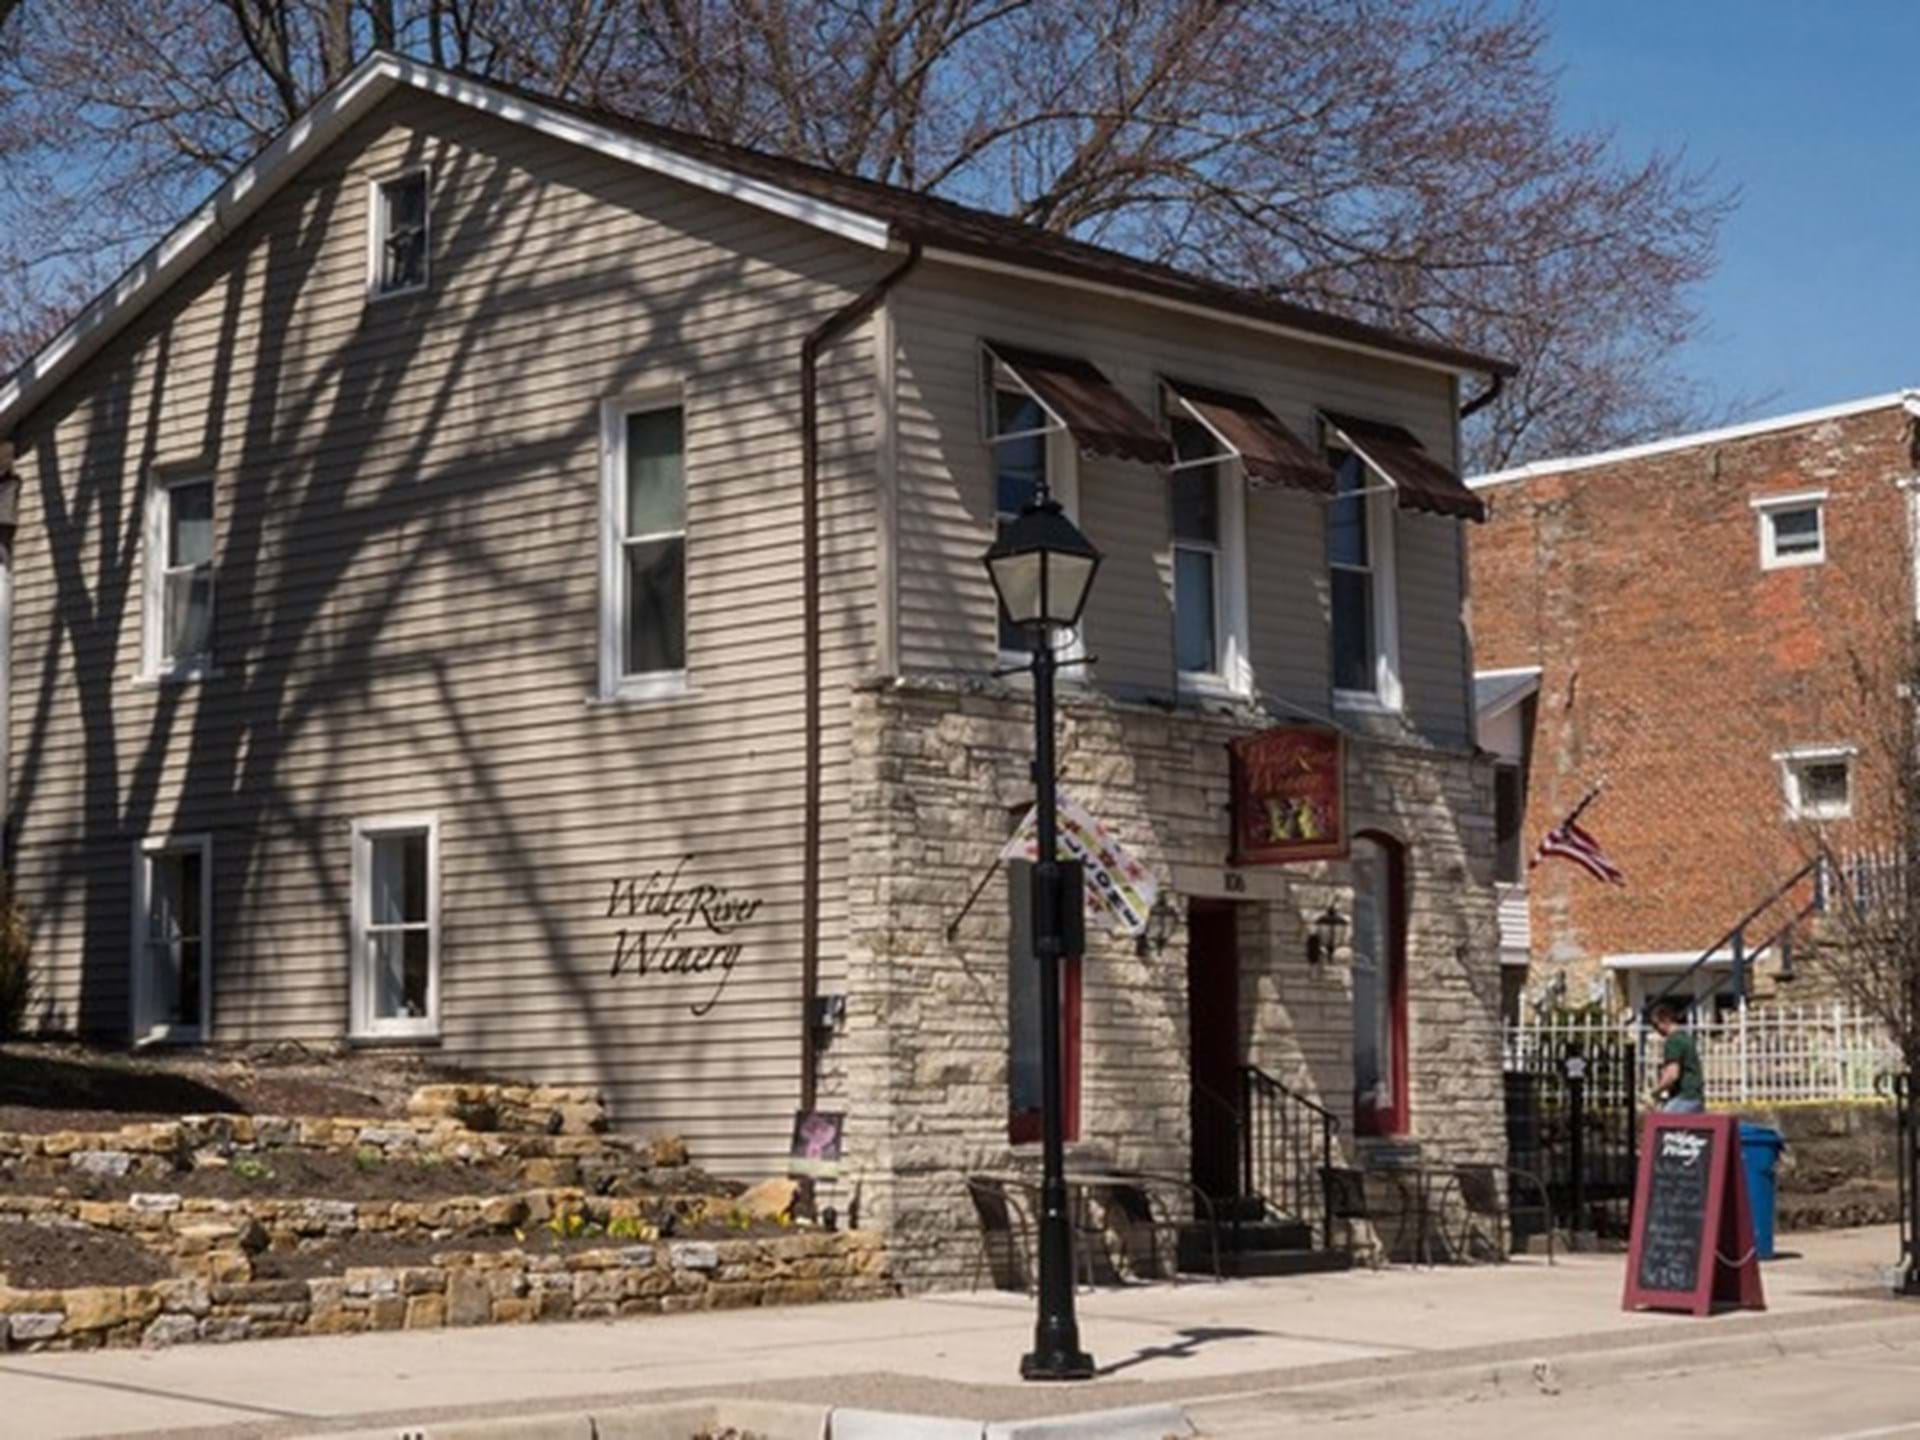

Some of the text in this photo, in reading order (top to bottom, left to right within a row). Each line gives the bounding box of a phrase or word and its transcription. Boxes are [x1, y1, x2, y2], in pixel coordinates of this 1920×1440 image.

[607, 854, 763, 934] Wide River
[610, 918, 743, 1016] Winery
